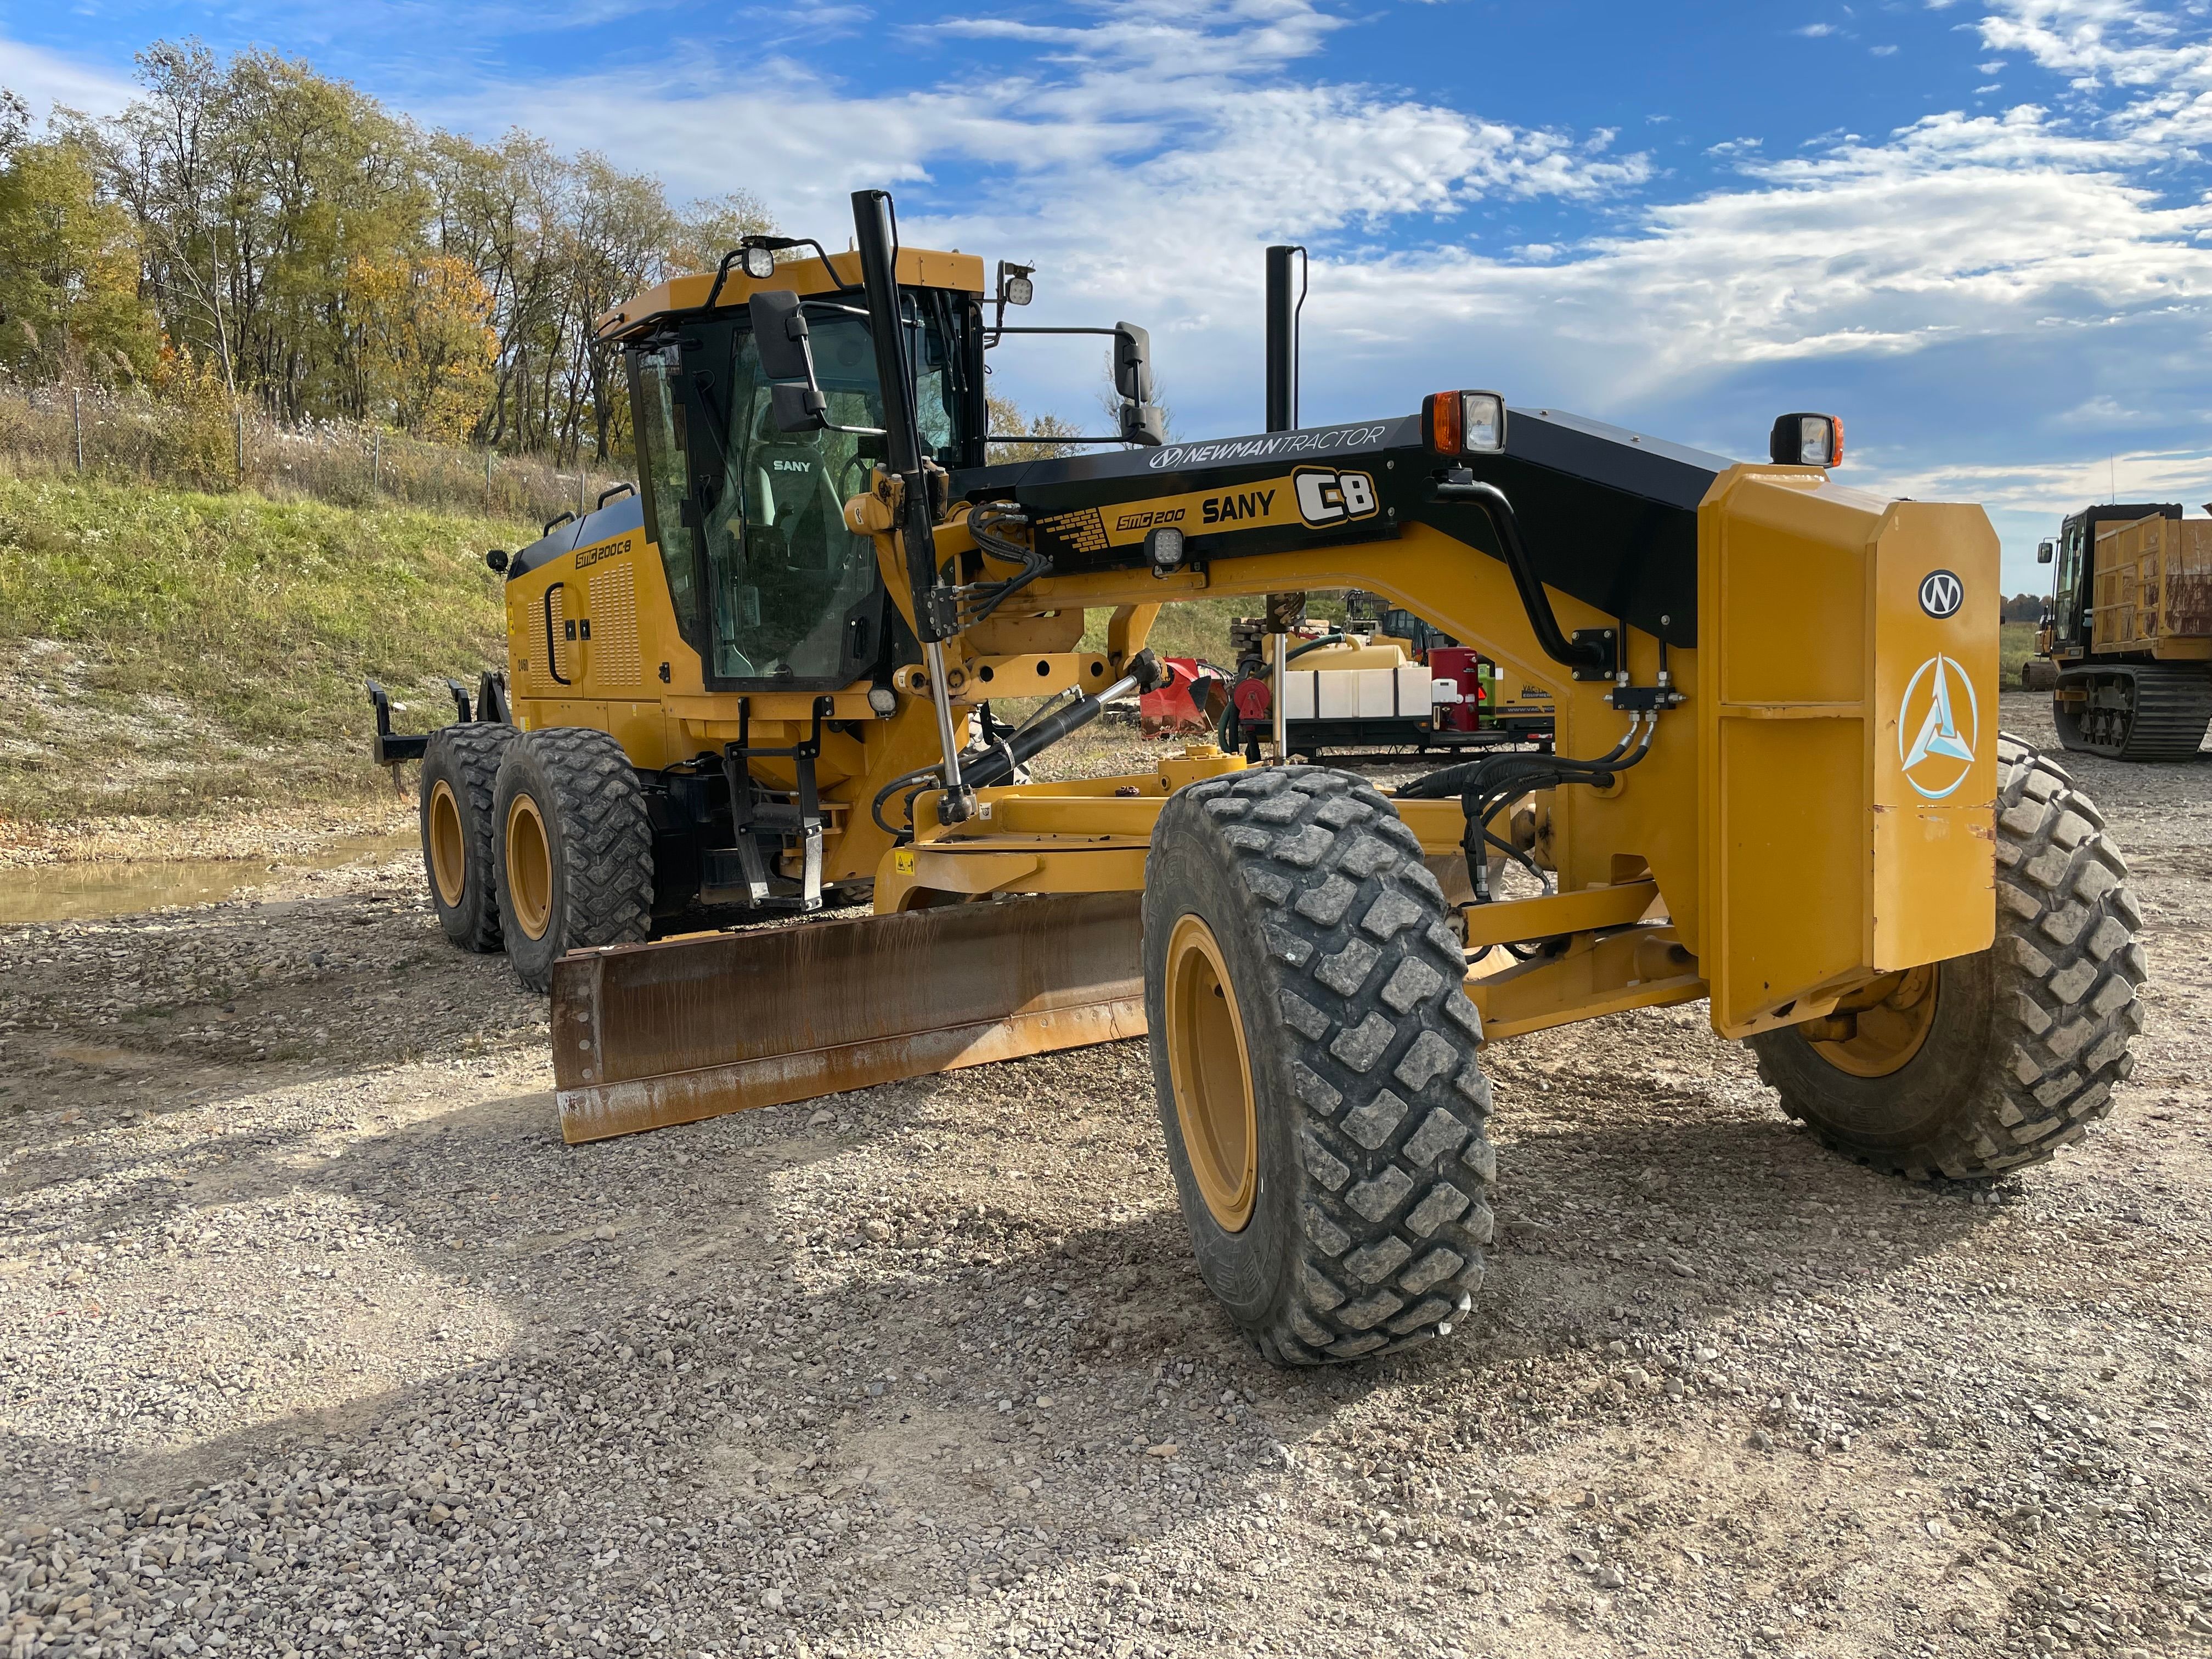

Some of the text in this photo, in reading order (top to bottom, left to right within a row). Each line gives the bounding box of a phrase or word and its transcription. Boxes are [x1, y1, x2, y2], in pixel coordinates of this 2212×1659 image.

[774, 460, 810, 472] SANY
[1202, 489, 1276, 524] SANY
[518, 659, 528, 672] 2460
